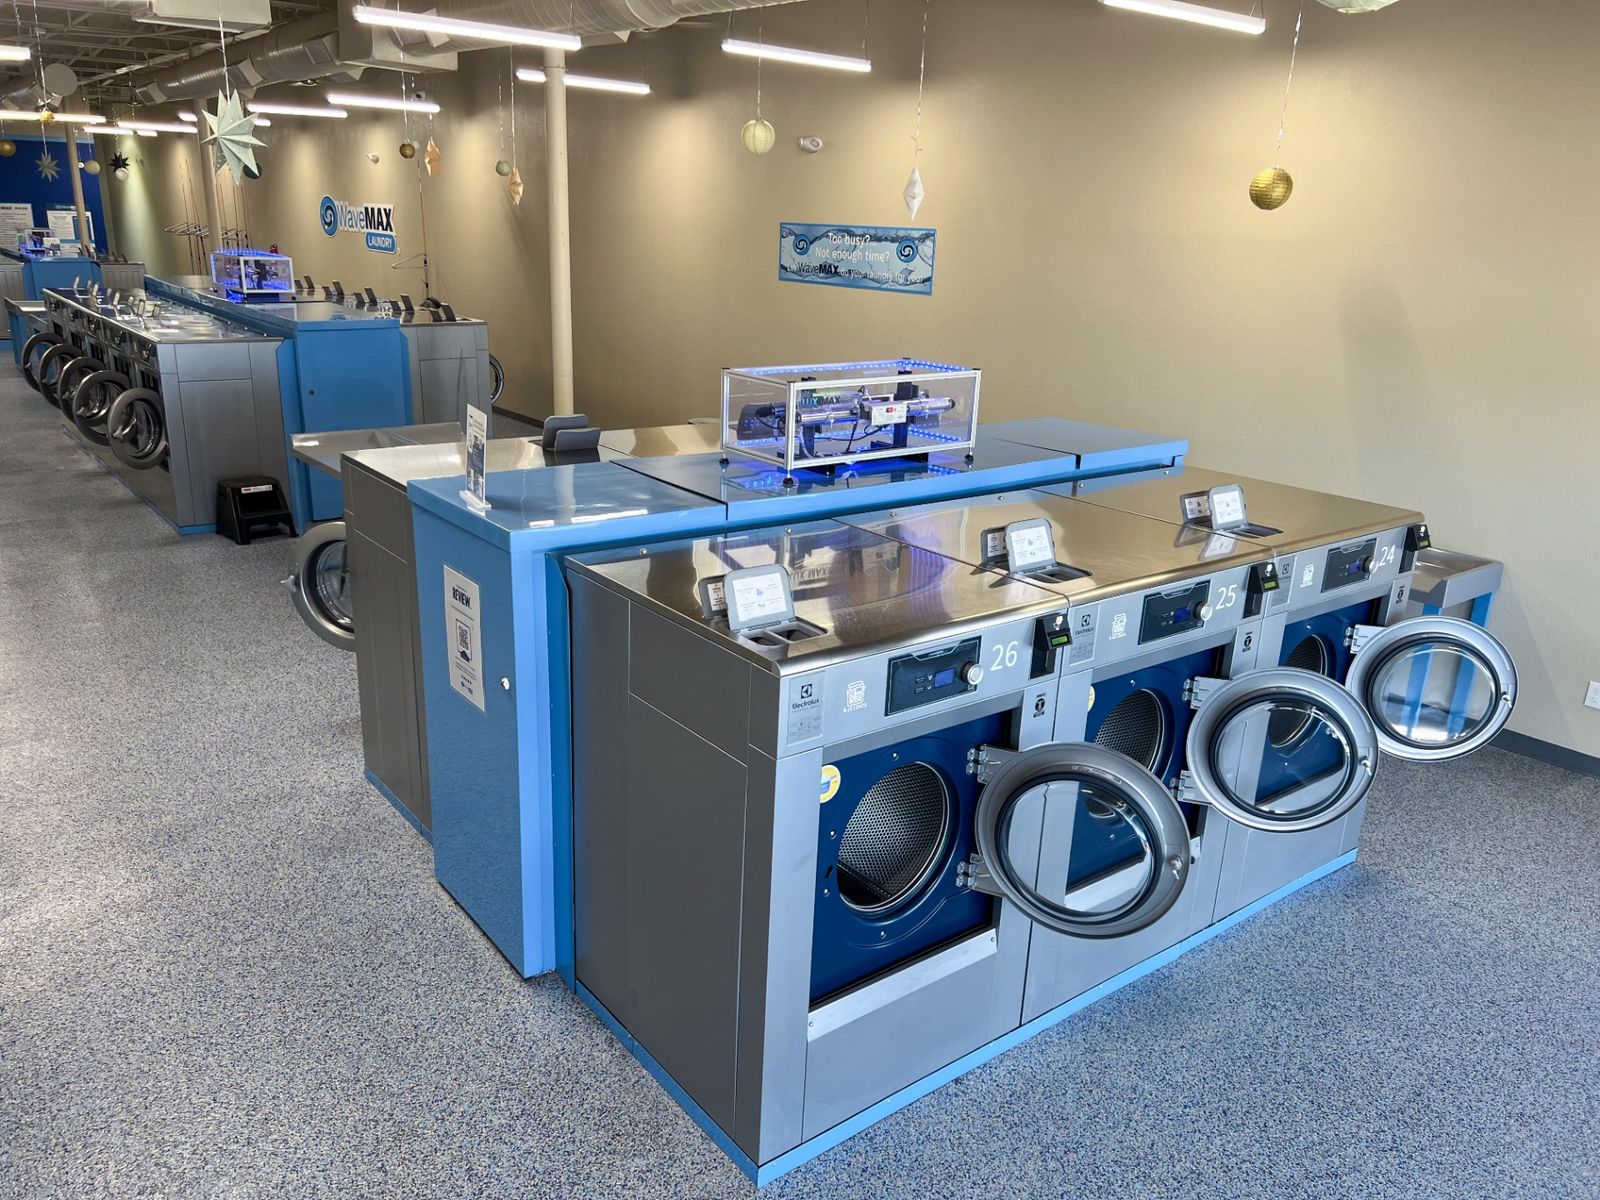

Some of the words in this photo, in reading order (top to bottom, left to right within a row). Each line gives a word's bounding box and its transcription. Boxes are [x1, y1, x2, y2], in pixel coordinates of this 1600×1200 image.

[336, 203, 393, 232] WaveMAX
[367, 235, 393, 249] LAUNDRY
[828, 232, 843, 245] Too
[815, 247, 830, 258] Not
[832, 250, 863, 264] enough
[865, 250, 890, 263] time?
[797, 261, 838, 276] WaveMAX
[1376, 544, 1396, 567] 24
[1215, 584, 1238, 610] 25
[990, 640, 1019, 671] 26
[792, 699, 819, 709] Electrolux
